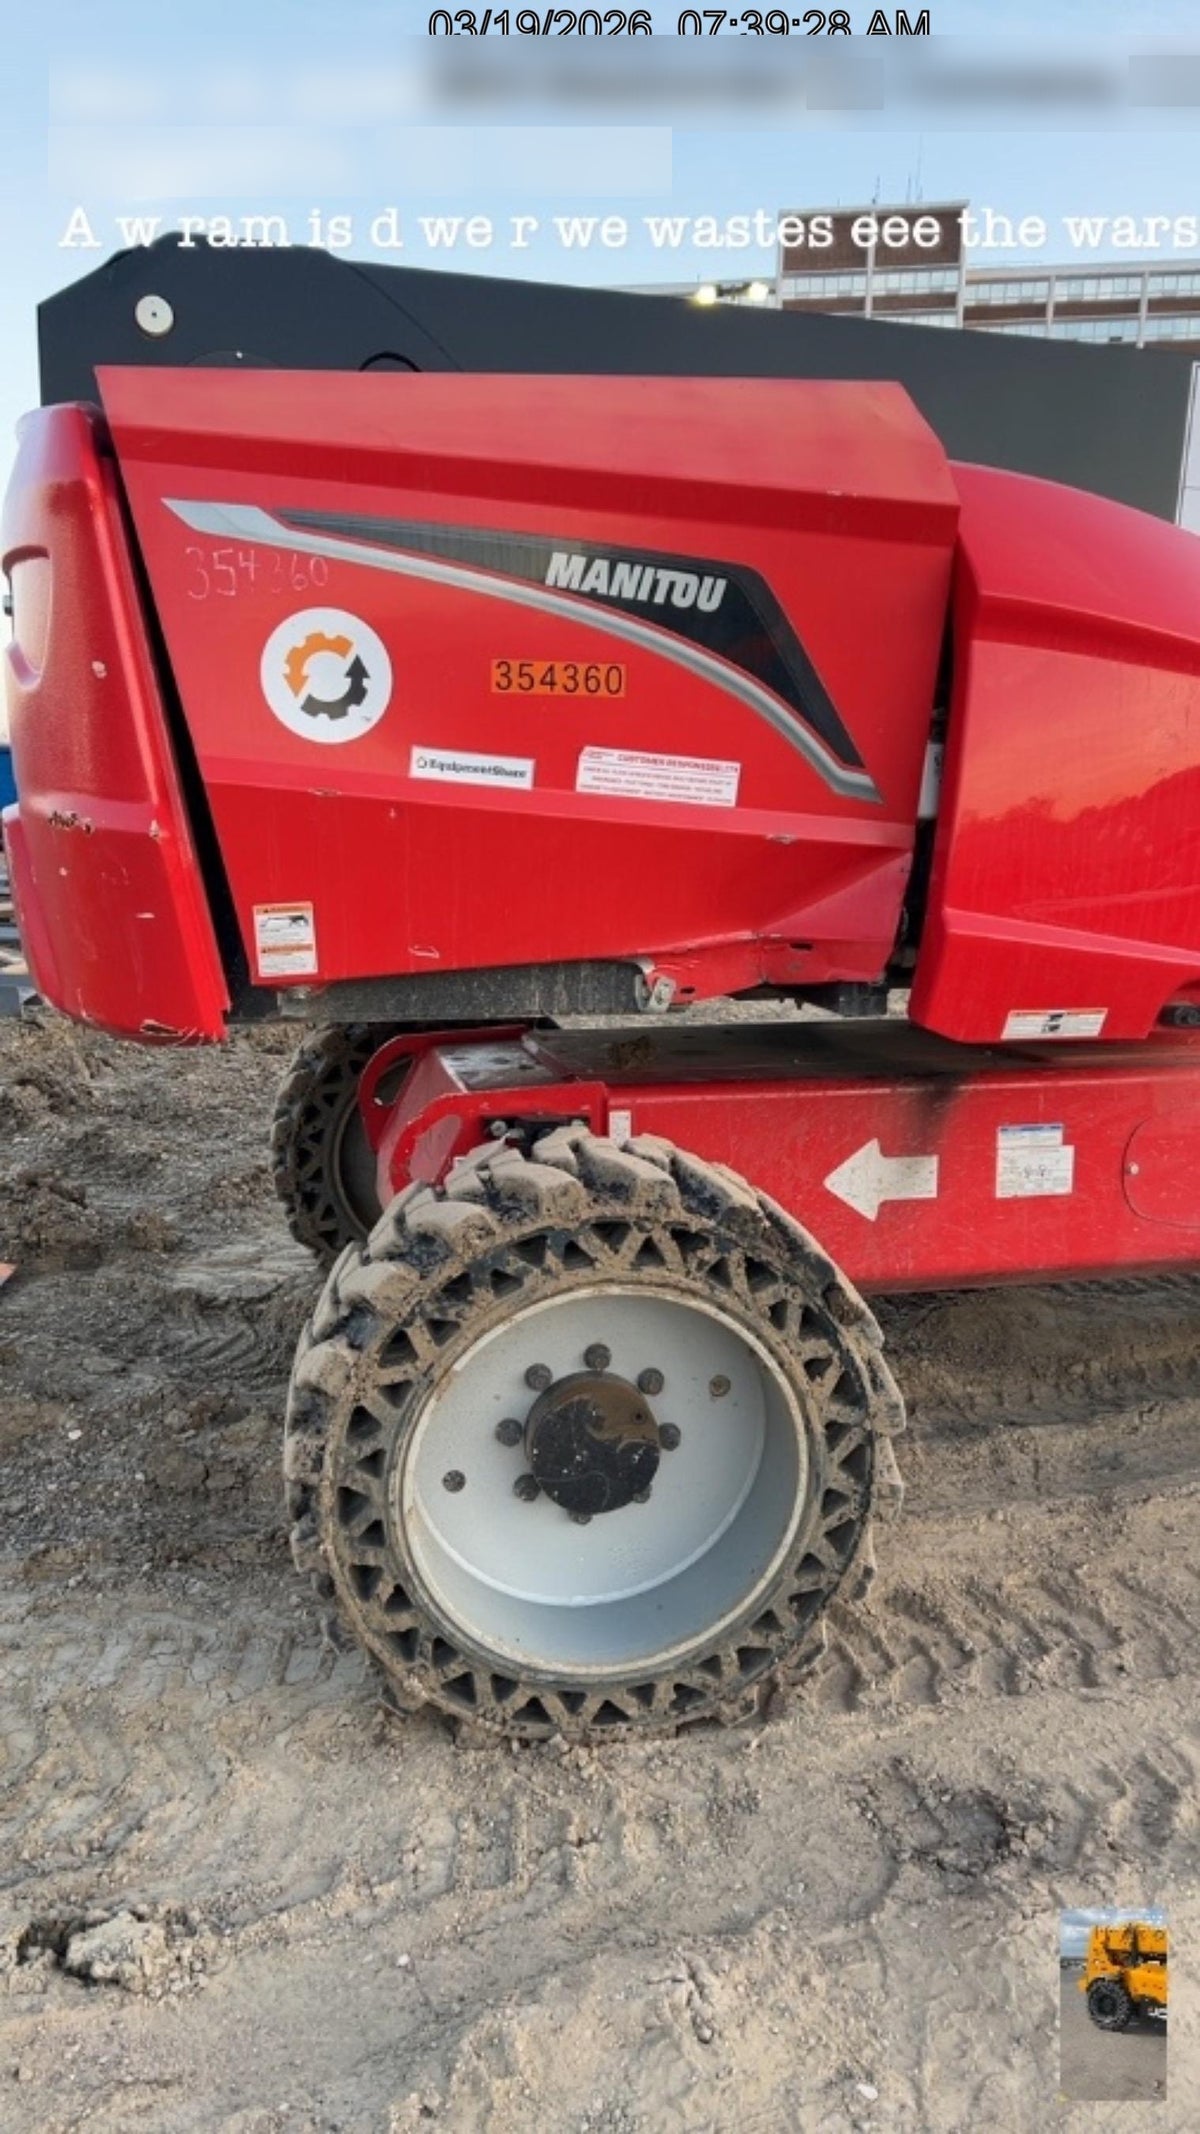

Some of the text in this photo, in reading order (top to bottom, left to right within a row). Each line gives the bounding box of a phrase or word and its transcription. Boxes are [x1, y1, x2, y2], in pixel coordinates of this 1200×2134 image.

[545, 552, 727, 613] MANITOU
[495, 660, 622, 695] 354360
[429, 758, 527, 778] EquipmentShare
